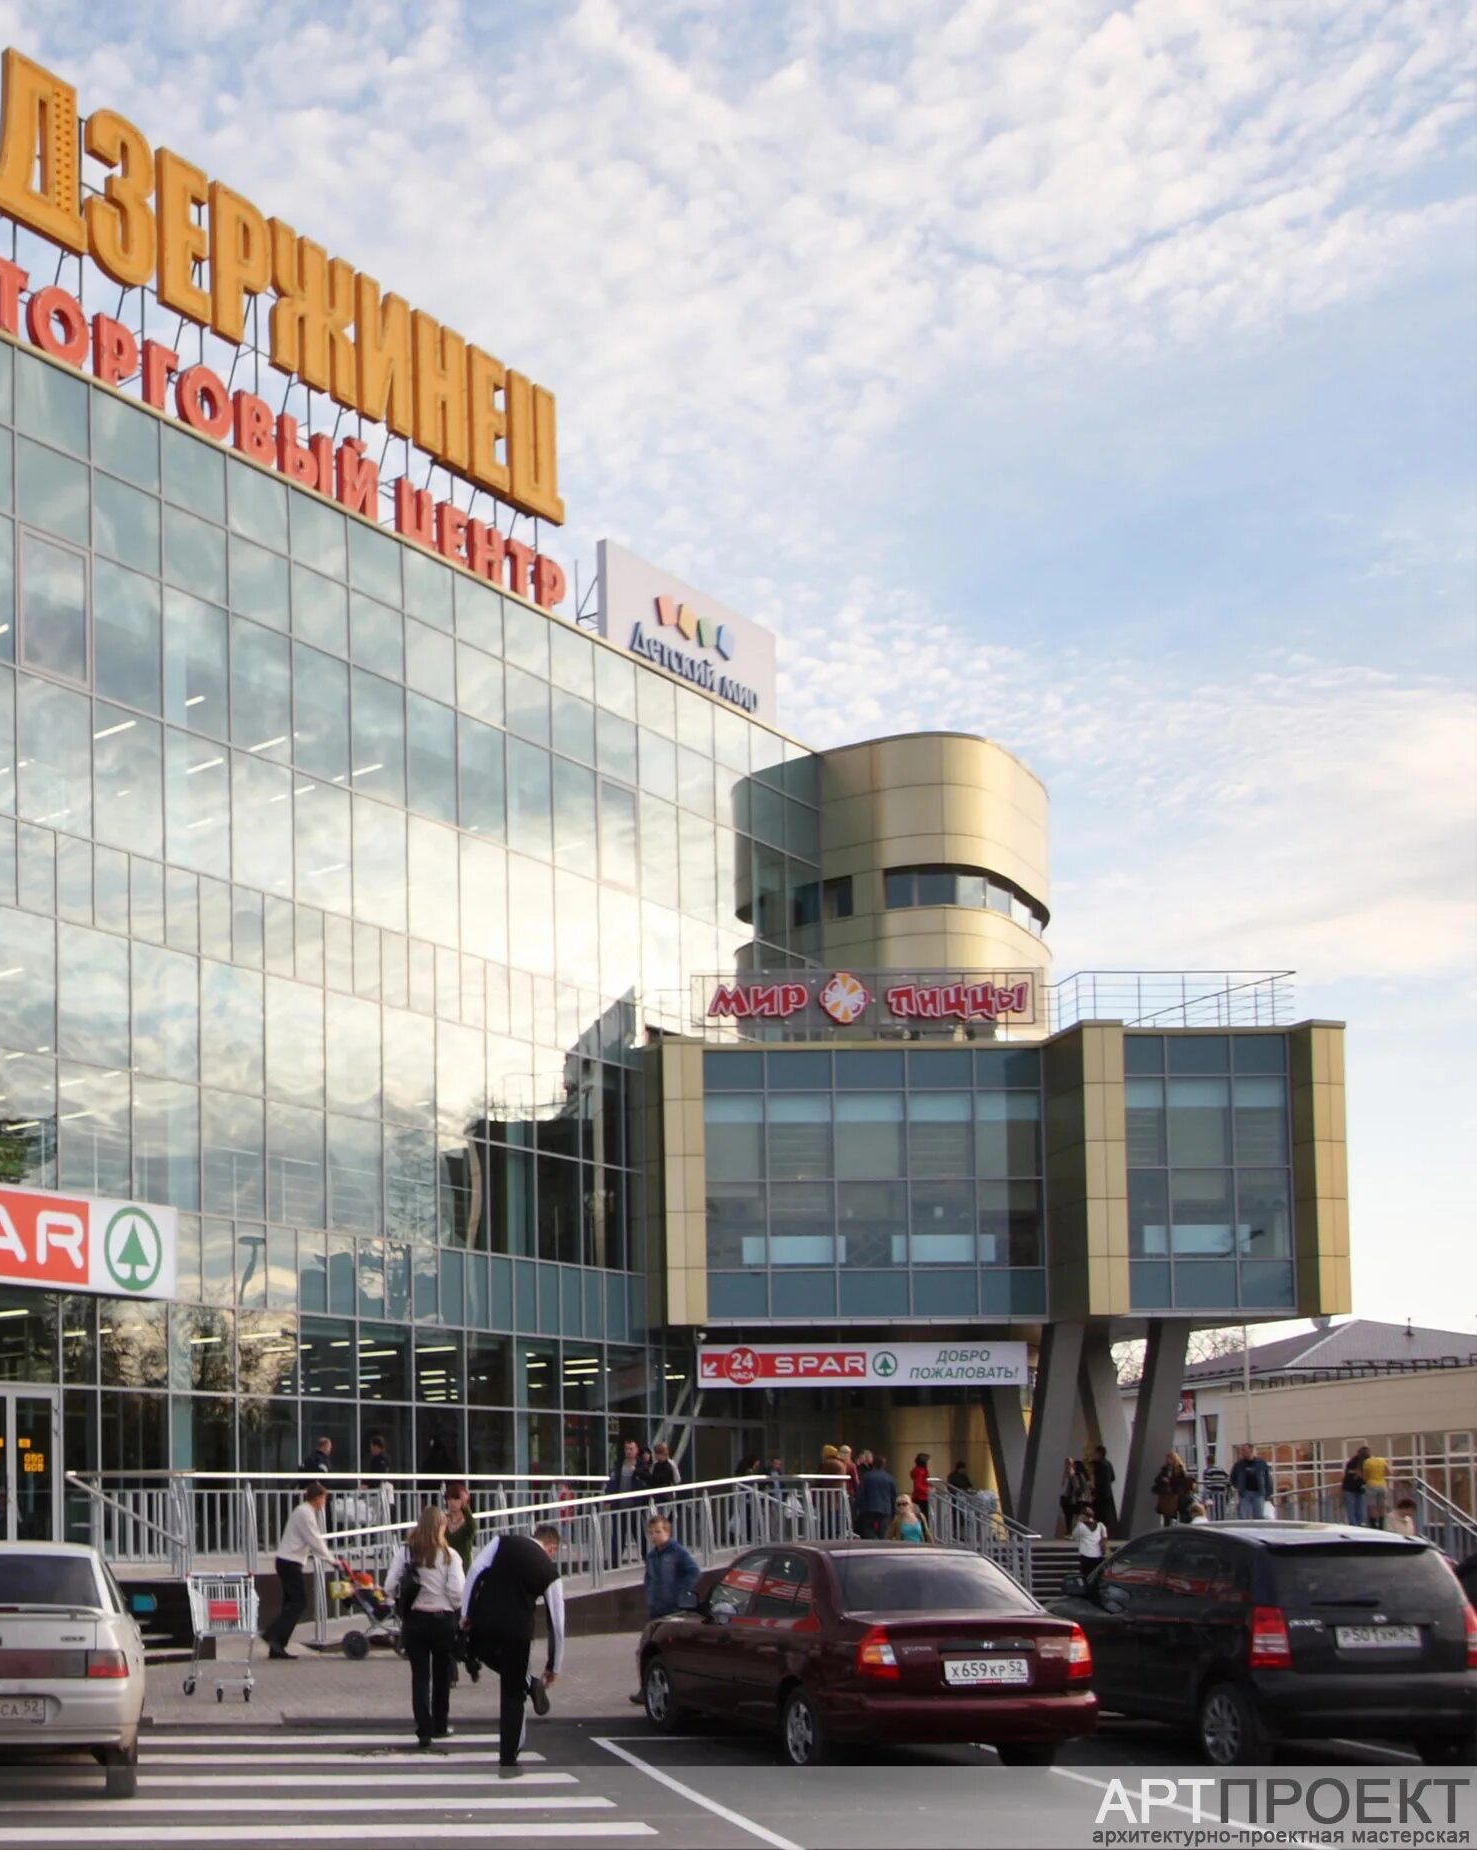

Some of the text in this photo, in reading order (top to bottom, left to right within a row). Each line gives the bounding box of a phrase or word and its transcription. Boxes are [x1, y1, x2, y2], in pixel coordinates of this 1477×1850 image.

[394, 476, 567, 609] ЦЕНТР
[708, 984, 809, 1018] МИР
[731, 1352, 755, 1370] 24
[775, 1356, 865, 1374] SPAR
[935, 1349, 991, 1365] ДОБРО
[729, 1371, 756, 1380] ЧАСА
[909, 1366, 1020, 1380] ПОЖАЛОВАТЬ!
